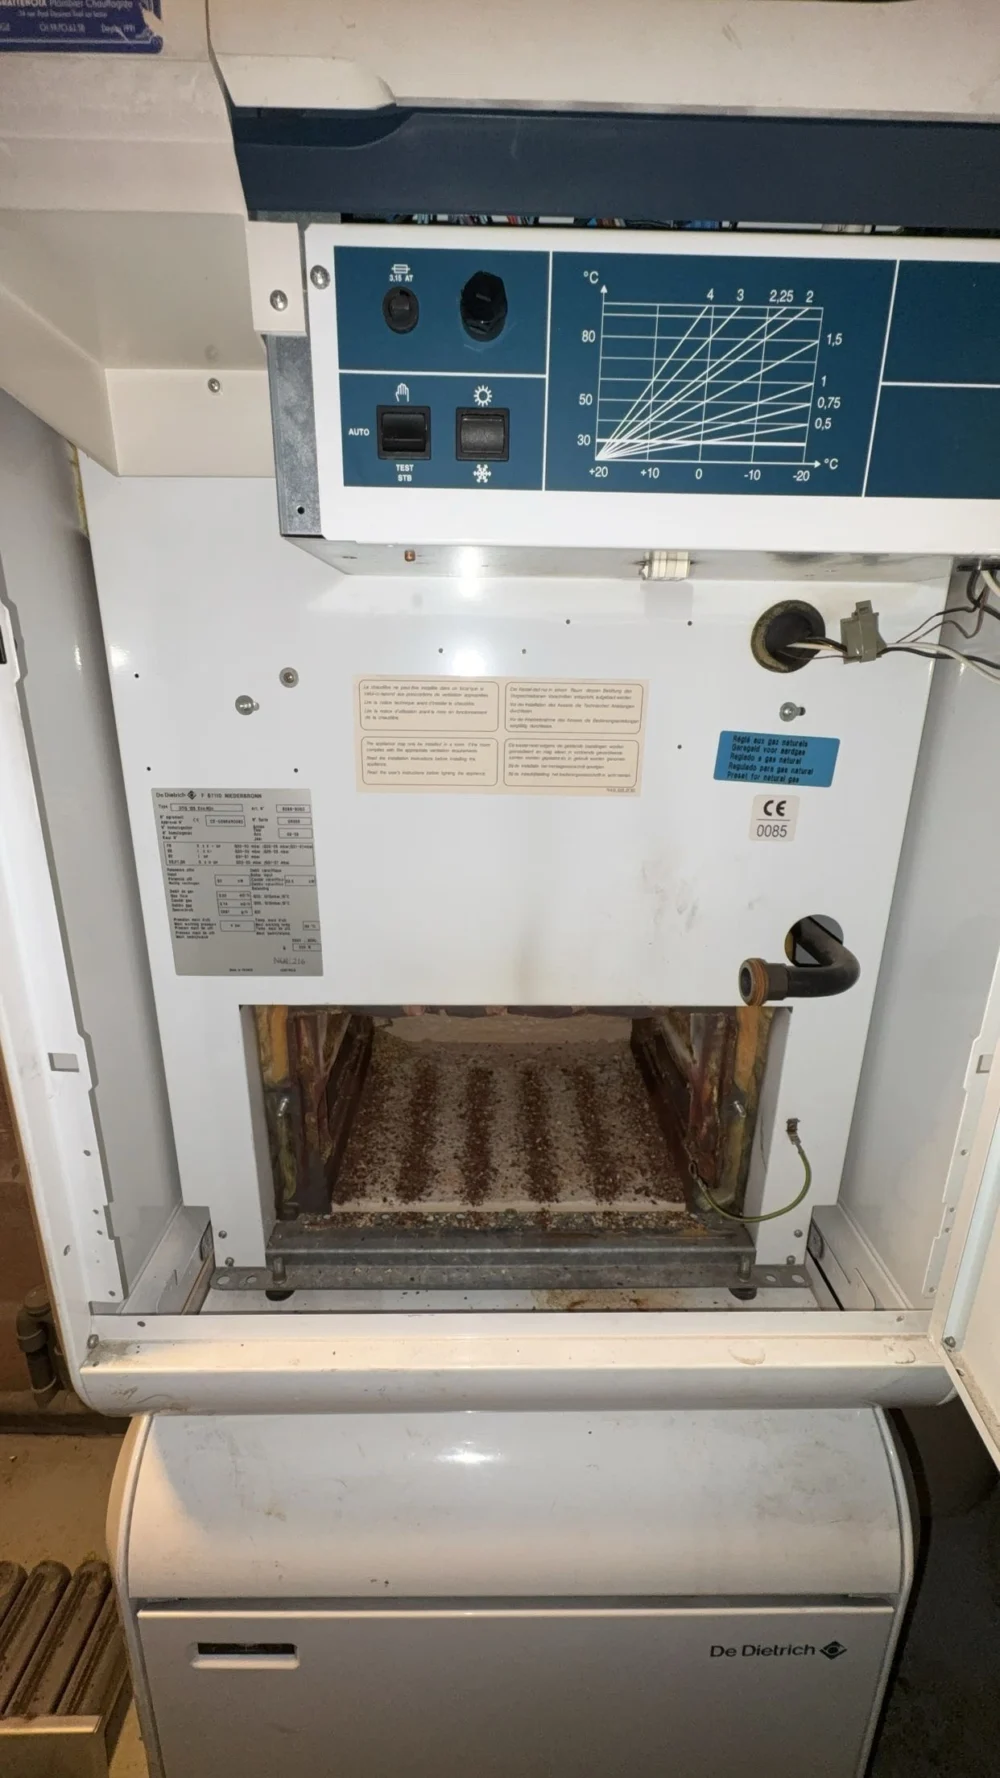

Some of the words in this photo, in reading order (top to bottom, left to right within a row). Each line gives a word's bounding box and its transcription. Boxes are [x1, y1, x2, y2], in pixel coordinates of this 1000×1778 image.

[706, 289, 715, 300] 4
[737, 289, 745, 301] 3
[769, 290, 794, 303] 2,25
[805, 291, 814, 303] 2
[582, 330, 596, 342] 80
[826, 333, 843, 347] 1,5
[821, 376, 827, 386] 1
[579, 393, 593, 405] 50
[817, 397, 841, 410] 0,75
[814, 418, 832, 430] 0,5
[348, 428, 370, 436] AUTO
[577, 434, 591, 445] 30
[396, 464, 414, 472] TEST
[589, 467, 608, 477] +20
[640, 468, 660, 478] +10
[695, 469, 703, 479] 0
[744, 470, 761, 481] -10
[793, 470, 810, 481] -20
[397, 474, 412, 482] STB
[782, 739, 808, 747] naturels
[764, 756, 776, 764] gas
[779, 757, 802, 765] natural
[760, 765, 774, 773] para
[791, 767, 814, 775] natural
[727, 771, 748, 780] Preset
[751, 772, 760, 780] for
[763, 774, 786, 782] natural
[788, 776, 800, 784] gas
[763, 799, 787, 817] CE
[756, 824, 787, 837] 0085
[709, 1645, 737, 1657] De
[741, 1644, 815, 1657] Dietrich
